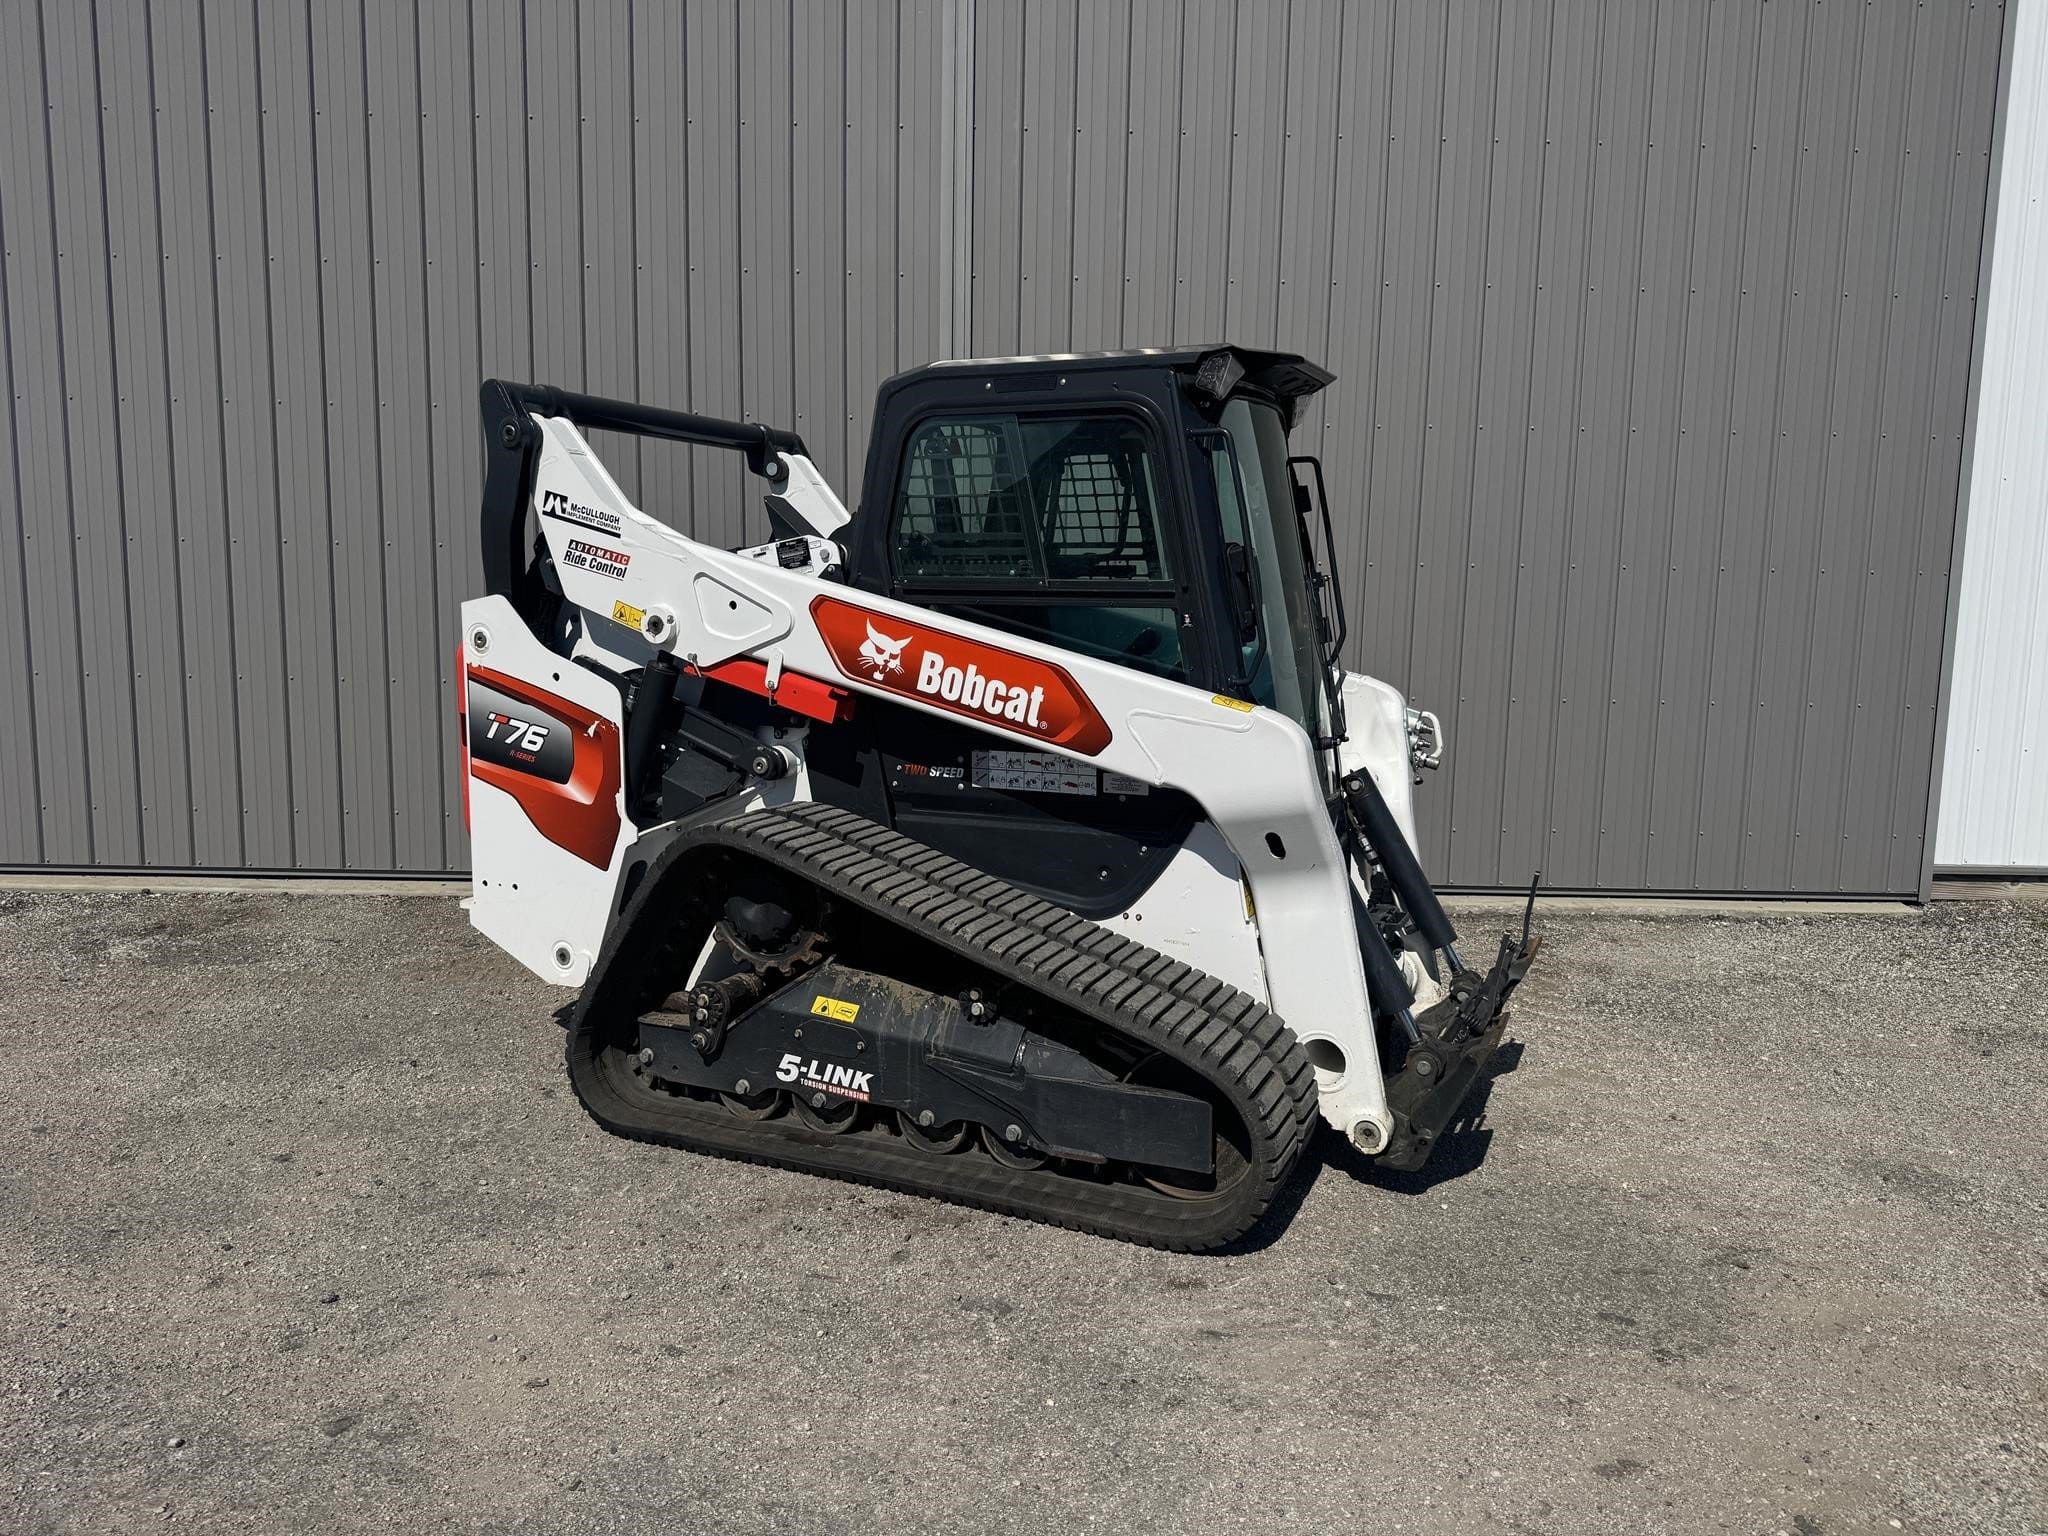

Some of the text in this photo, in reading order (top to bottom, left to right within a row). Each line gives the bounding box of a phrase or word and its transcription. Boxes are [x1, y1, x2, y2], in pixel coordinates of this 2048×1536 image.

[567, 511, 621, 531] IMPLEMENT COMPANY
[564, 550, 627, 578] Ride Control
[570, 541, 629, 565] AUTOMATIC
[916, 650, 1045, 728] Bobcat
[486, 712, 549, 752] T76
[509, 750, 537, 763] R-SERIES
[904, 764, 965, 778] TWO SPEED
[775, 1053, 875, 1093] 5-LINK
[800, 1078, 870, 1101] TORSION SUSPENSION
